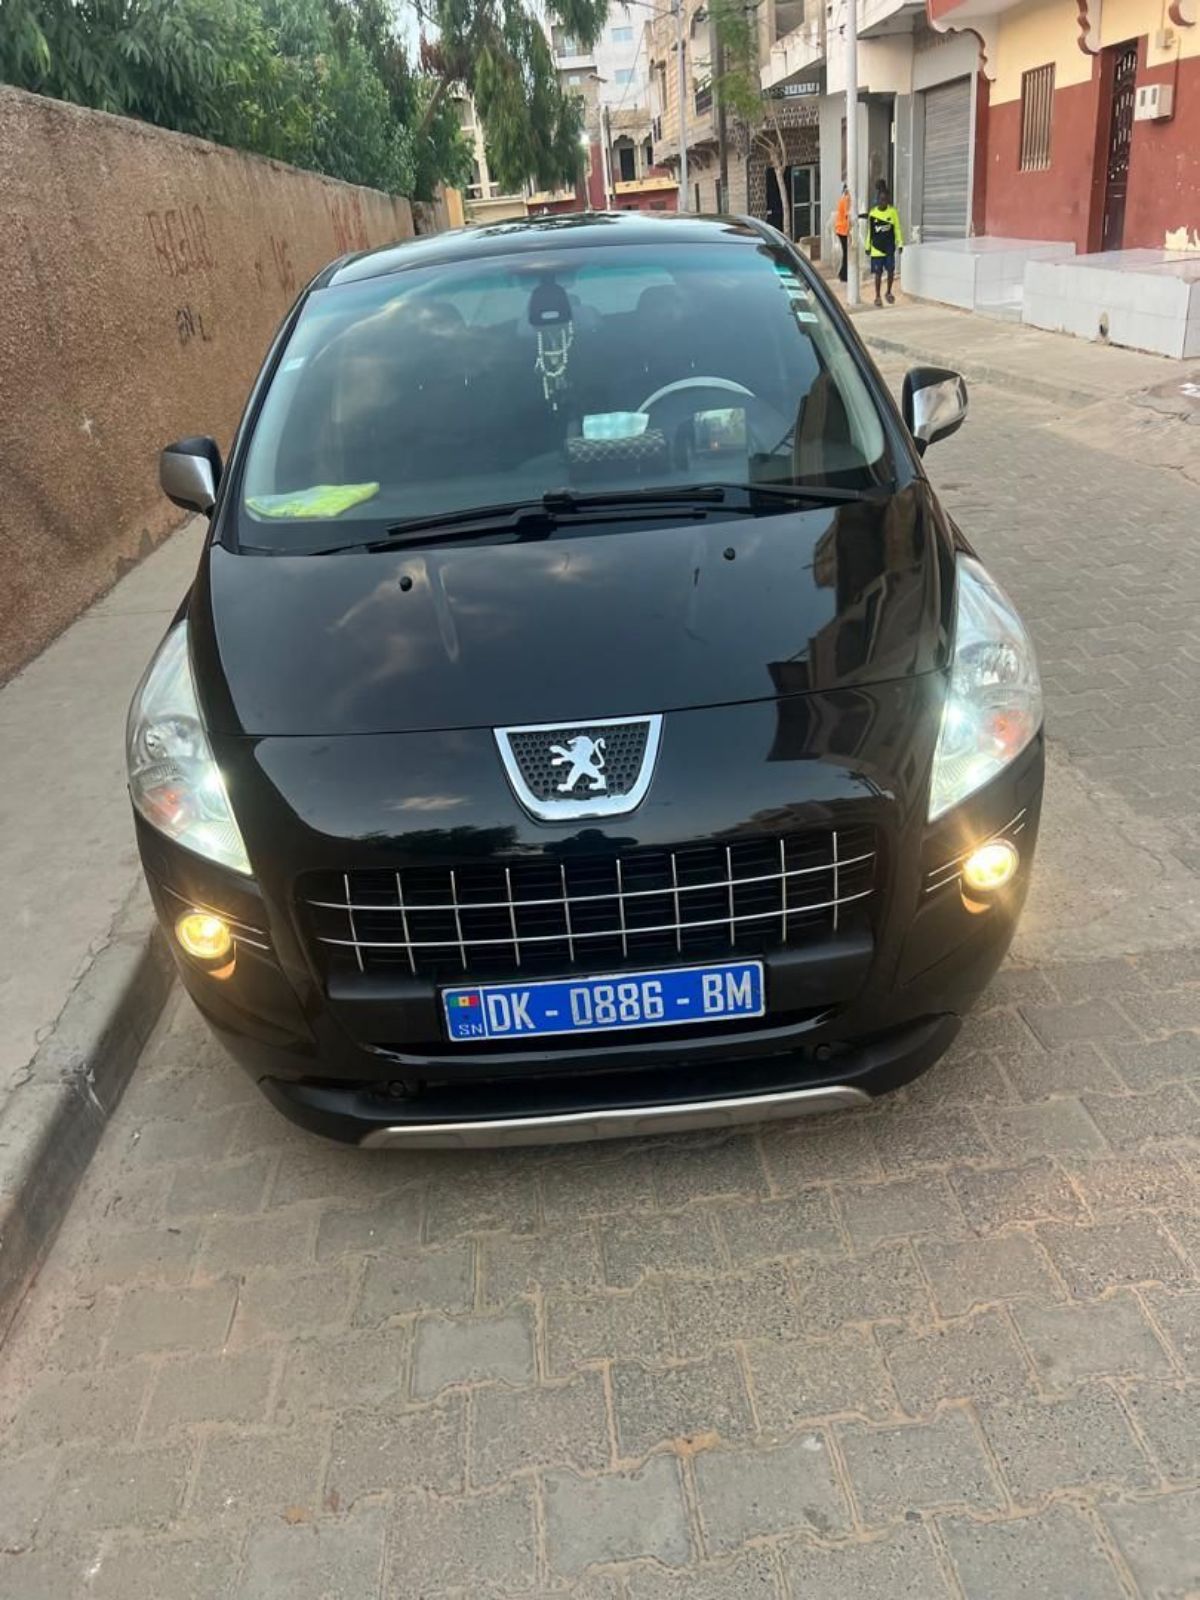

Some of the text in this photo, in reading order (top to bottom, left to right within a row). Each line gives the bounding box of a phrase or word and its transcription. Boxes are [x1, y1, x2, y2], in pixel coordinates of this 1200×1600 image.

[487, 992, 536, 1031] DK
[570, 981, 664, 1025] 0886
[702, 971, 752, 1012] BM
[458, 1023, 482, 1035] SN
